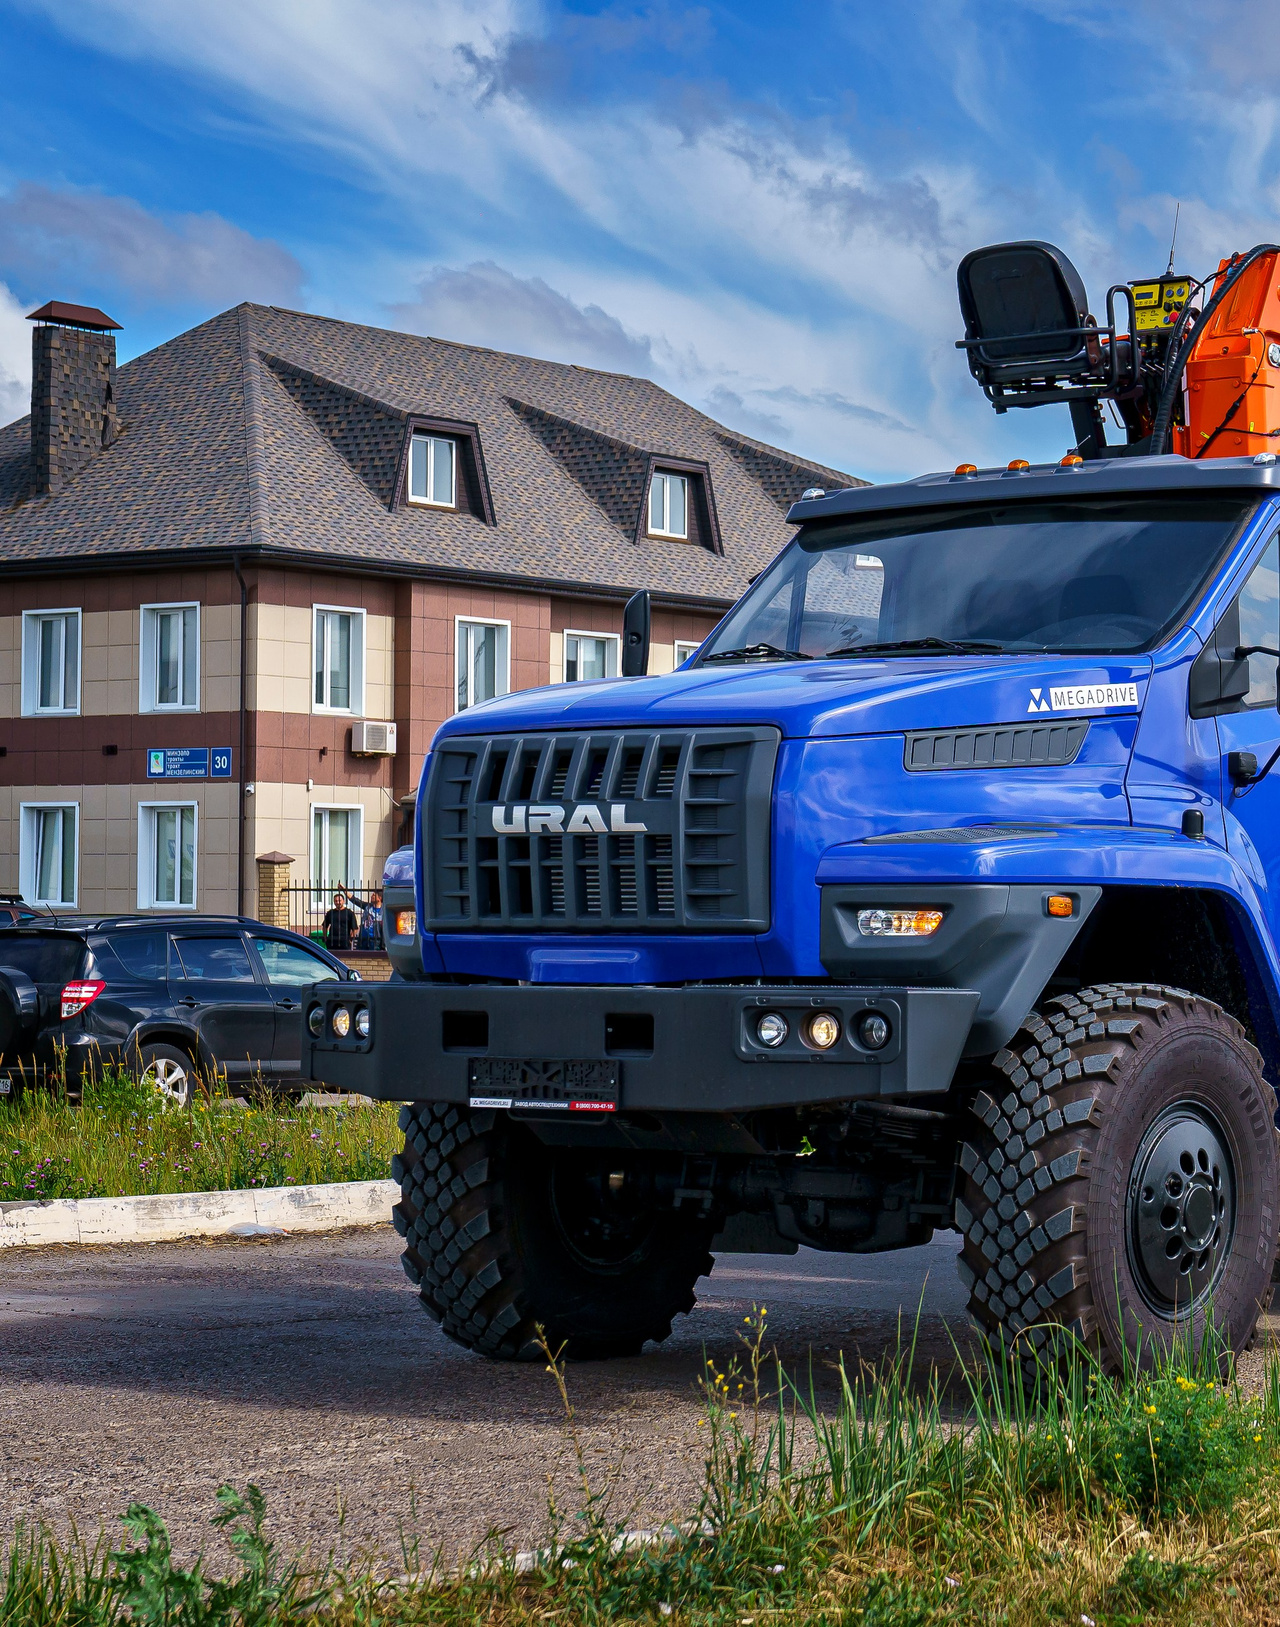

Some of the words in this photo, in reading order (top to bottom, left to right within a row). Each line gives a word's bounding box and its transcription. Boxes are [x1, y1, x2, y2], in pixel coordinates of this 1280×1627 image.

[1054, 687, 1136, 707] MEGADRIVE
[214, 755, 228, 769] 30
[166, 768, 206, 776] МЕНЗЕЛИНСКИЙ
[491, 804, 648, 833] URAL
